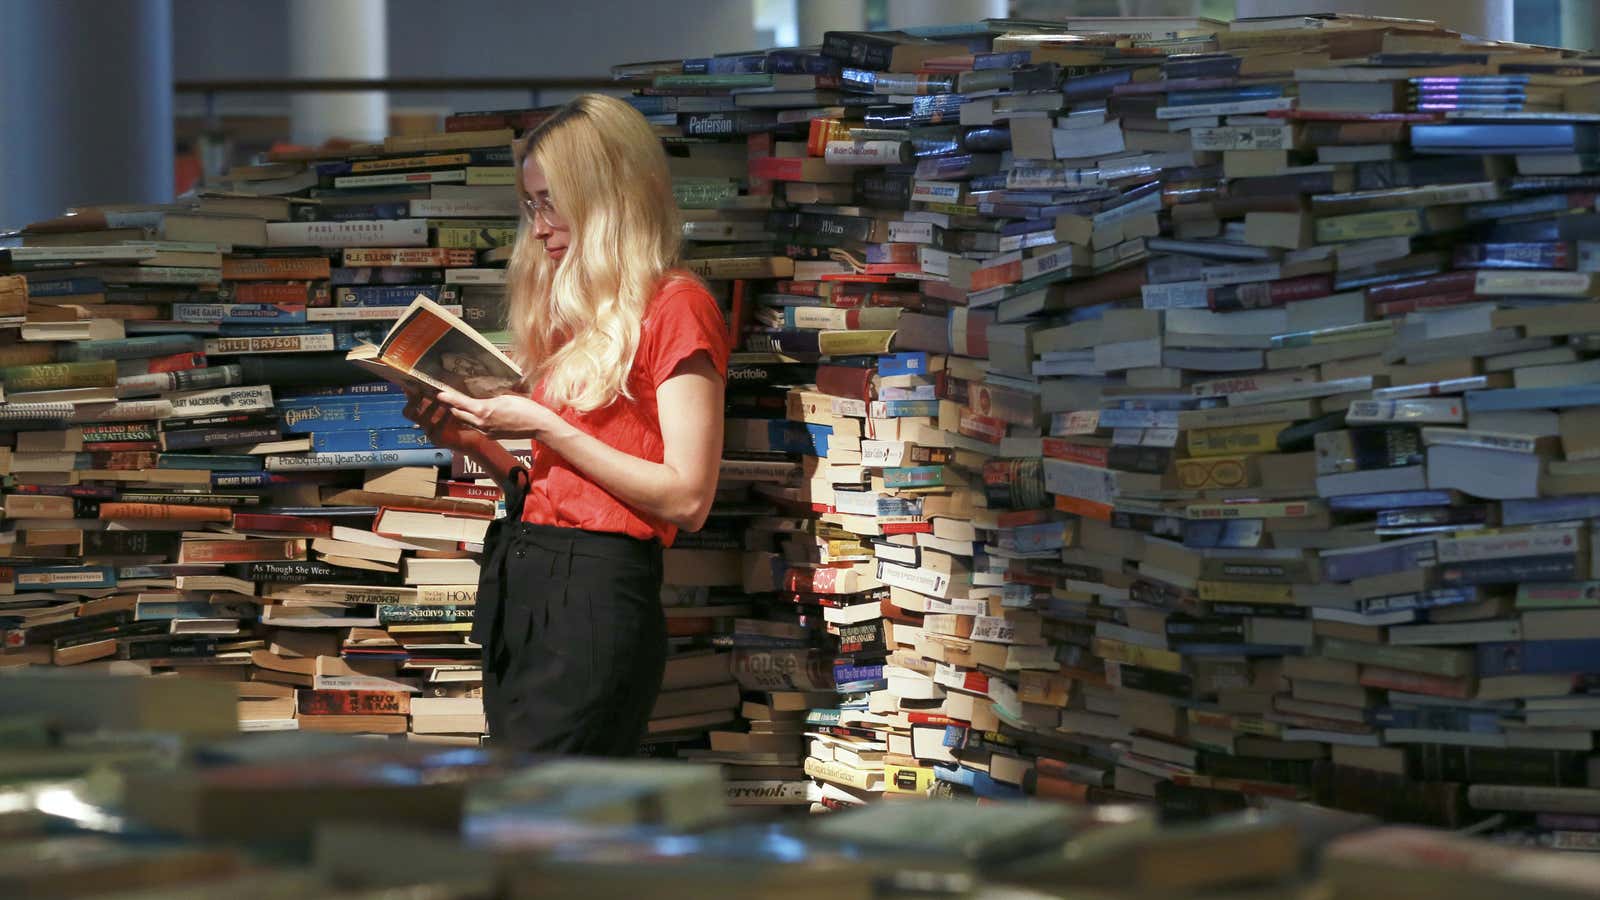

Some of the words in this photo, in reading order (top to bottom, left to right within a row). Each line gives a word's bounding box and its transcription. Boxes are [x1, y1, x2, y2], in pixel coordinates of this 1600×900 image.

[689, 116, 733, 134] Patterson
[252, 337, 300, 350] BRYSON
[728, 369, 767, 381] Portfolio
[351, 386, 370, 394] PETER
[371, 385, 389, 393] JONES
[98, 425, 125, 434] BLIND
[279, 453, 333, 466] Photography
[335, 453, 353, 465] Year
[355, 452, 378, 464] Book
[380, 452, 399, 463] 1980
[254, 564, 263, 572] As
[266, 564, 293, 576] Though
[296, 566, 309, 575] She
[311, 567, 330, 576] Were
[344, 593, 365, 602] LANE
[447, 591, 477, 602] HOM
[408, 609, 444, 617] GARDENS
